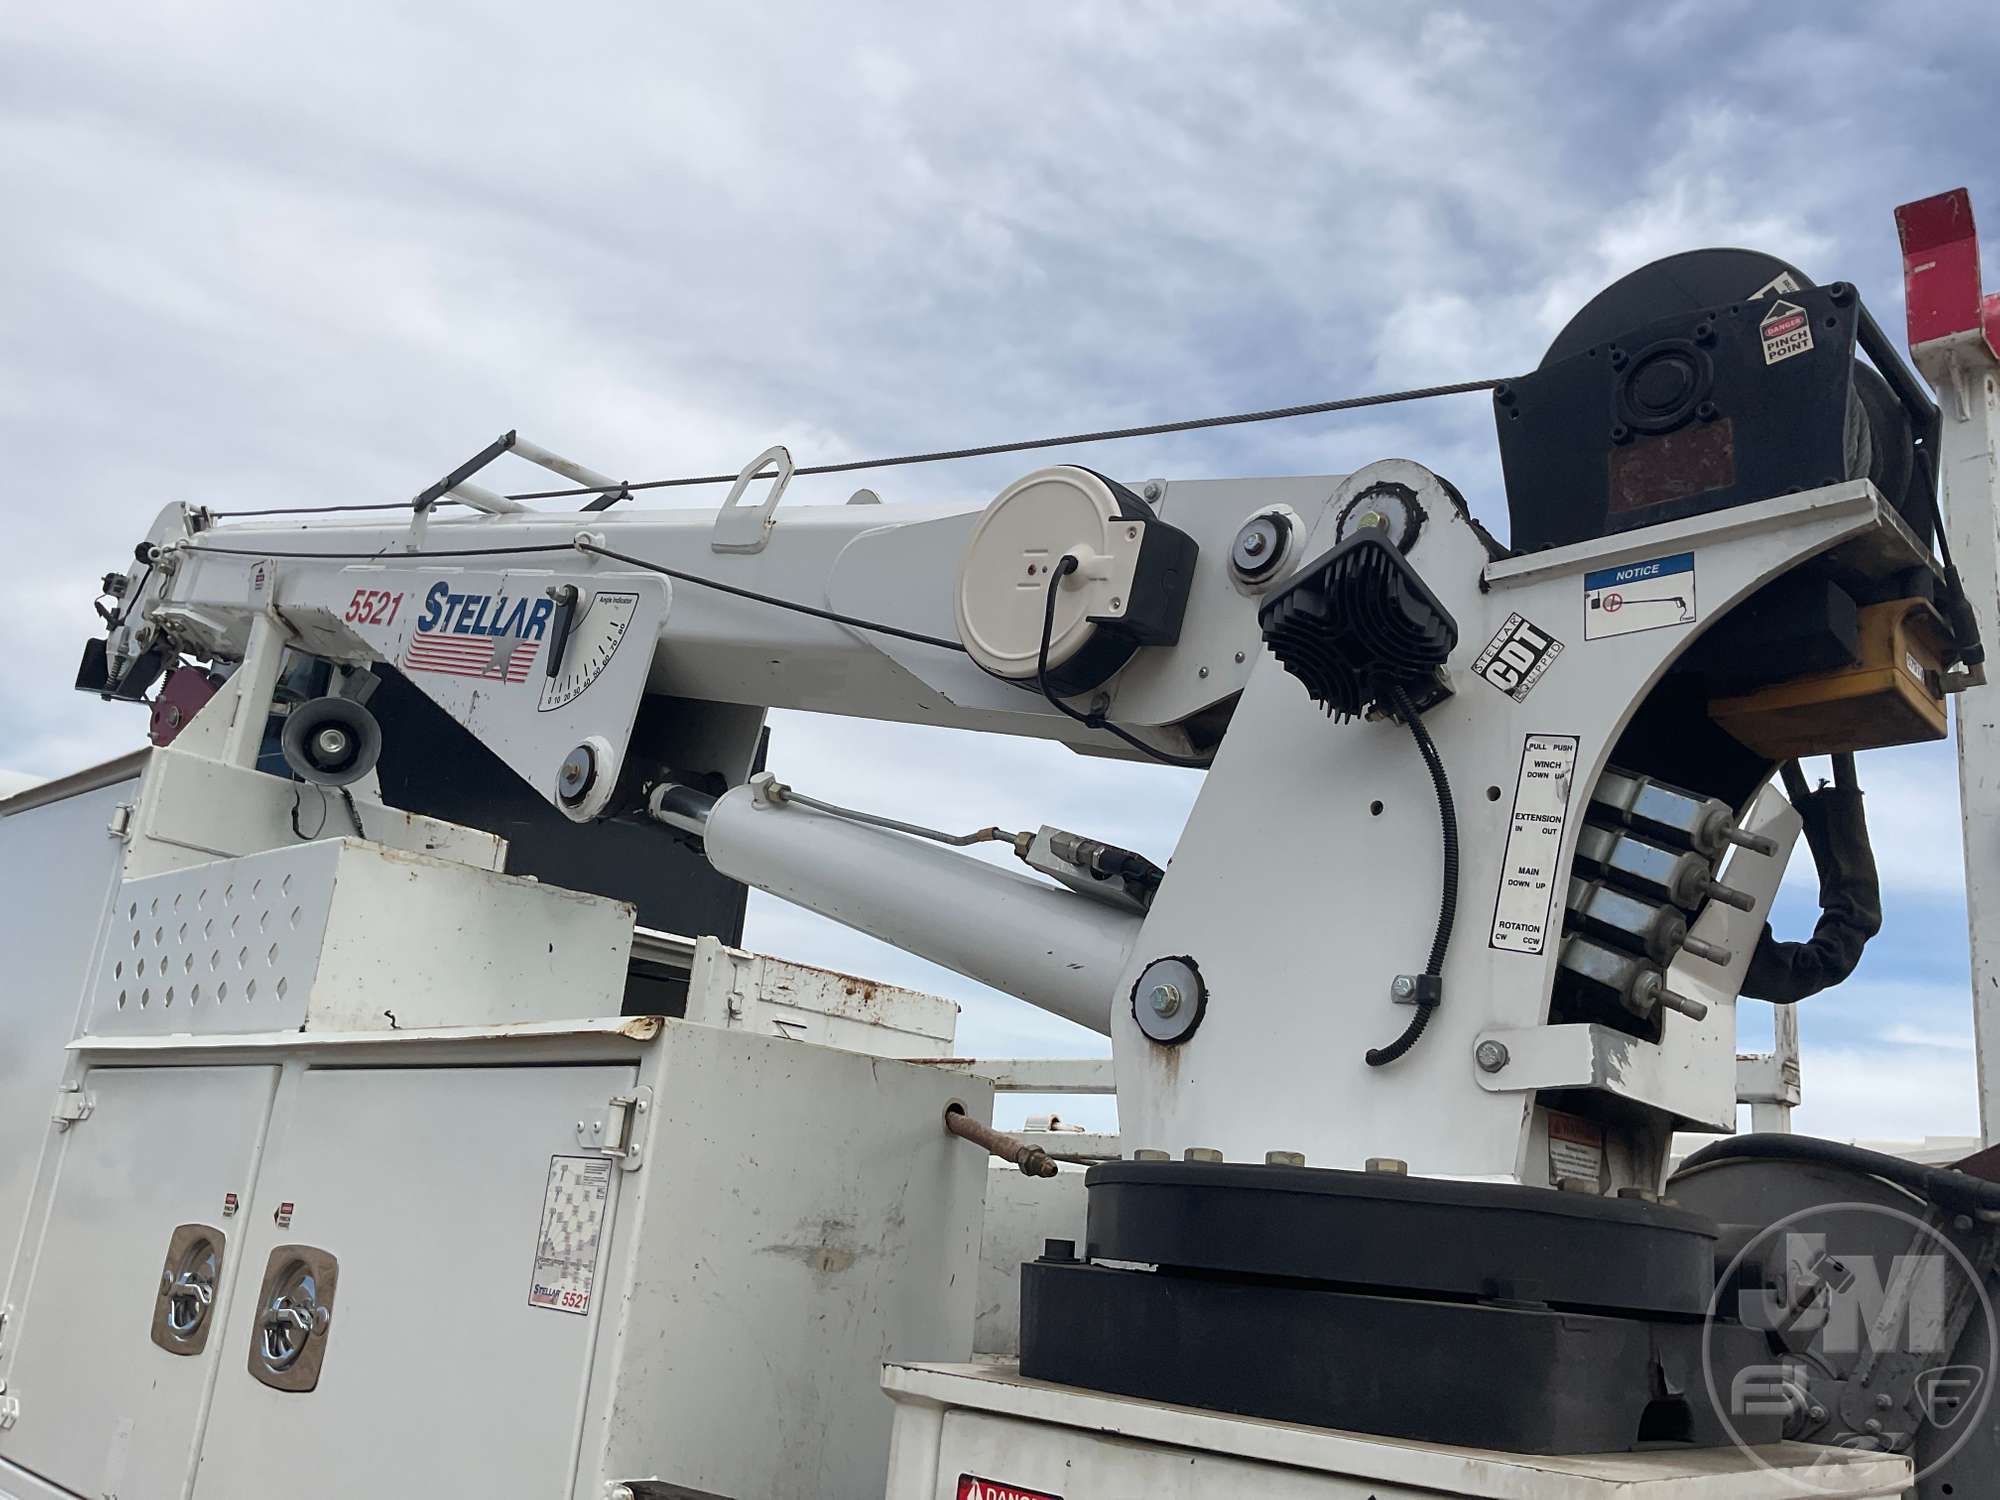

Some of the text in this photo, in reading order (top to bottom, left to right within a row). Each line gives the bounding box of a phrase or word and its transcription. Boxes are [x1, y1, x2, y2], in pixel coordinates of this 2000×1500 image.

[1767, 318, 1803, 335] DANGER
[1767, 330, 1808, 351] PINCH
[1769, 338, 1809, 360] POINT
[1616, 563, 1660, 582] NOTICE
[345, 589, 405, 627] 5521
[417, 581, 554, 641] STELLAR
[1475, 615, 1519, 672] STELLAR
[1486, 621, 1547, 692] CDT
[1514, 643, 1561, 700] EQUIPPED
[1529, 743, 1547, 751] PULL
[1534, 760, 1561, 769] WINCH
[1527, 771, 1549, 779] DOWN
[1515, 812, 1561, 824] EXTENSION
[1542, 827, 1557, 835] OUT
[1518, 866, 1540, 876] MAIN
[1508, 879, 1530, 888] DOWN
[1499, 920, 1540, 933] ROTATION
[1495, 933, 1540, 945] CW CCW
[533, 1283, 588, 1310] STELLAR 5521
